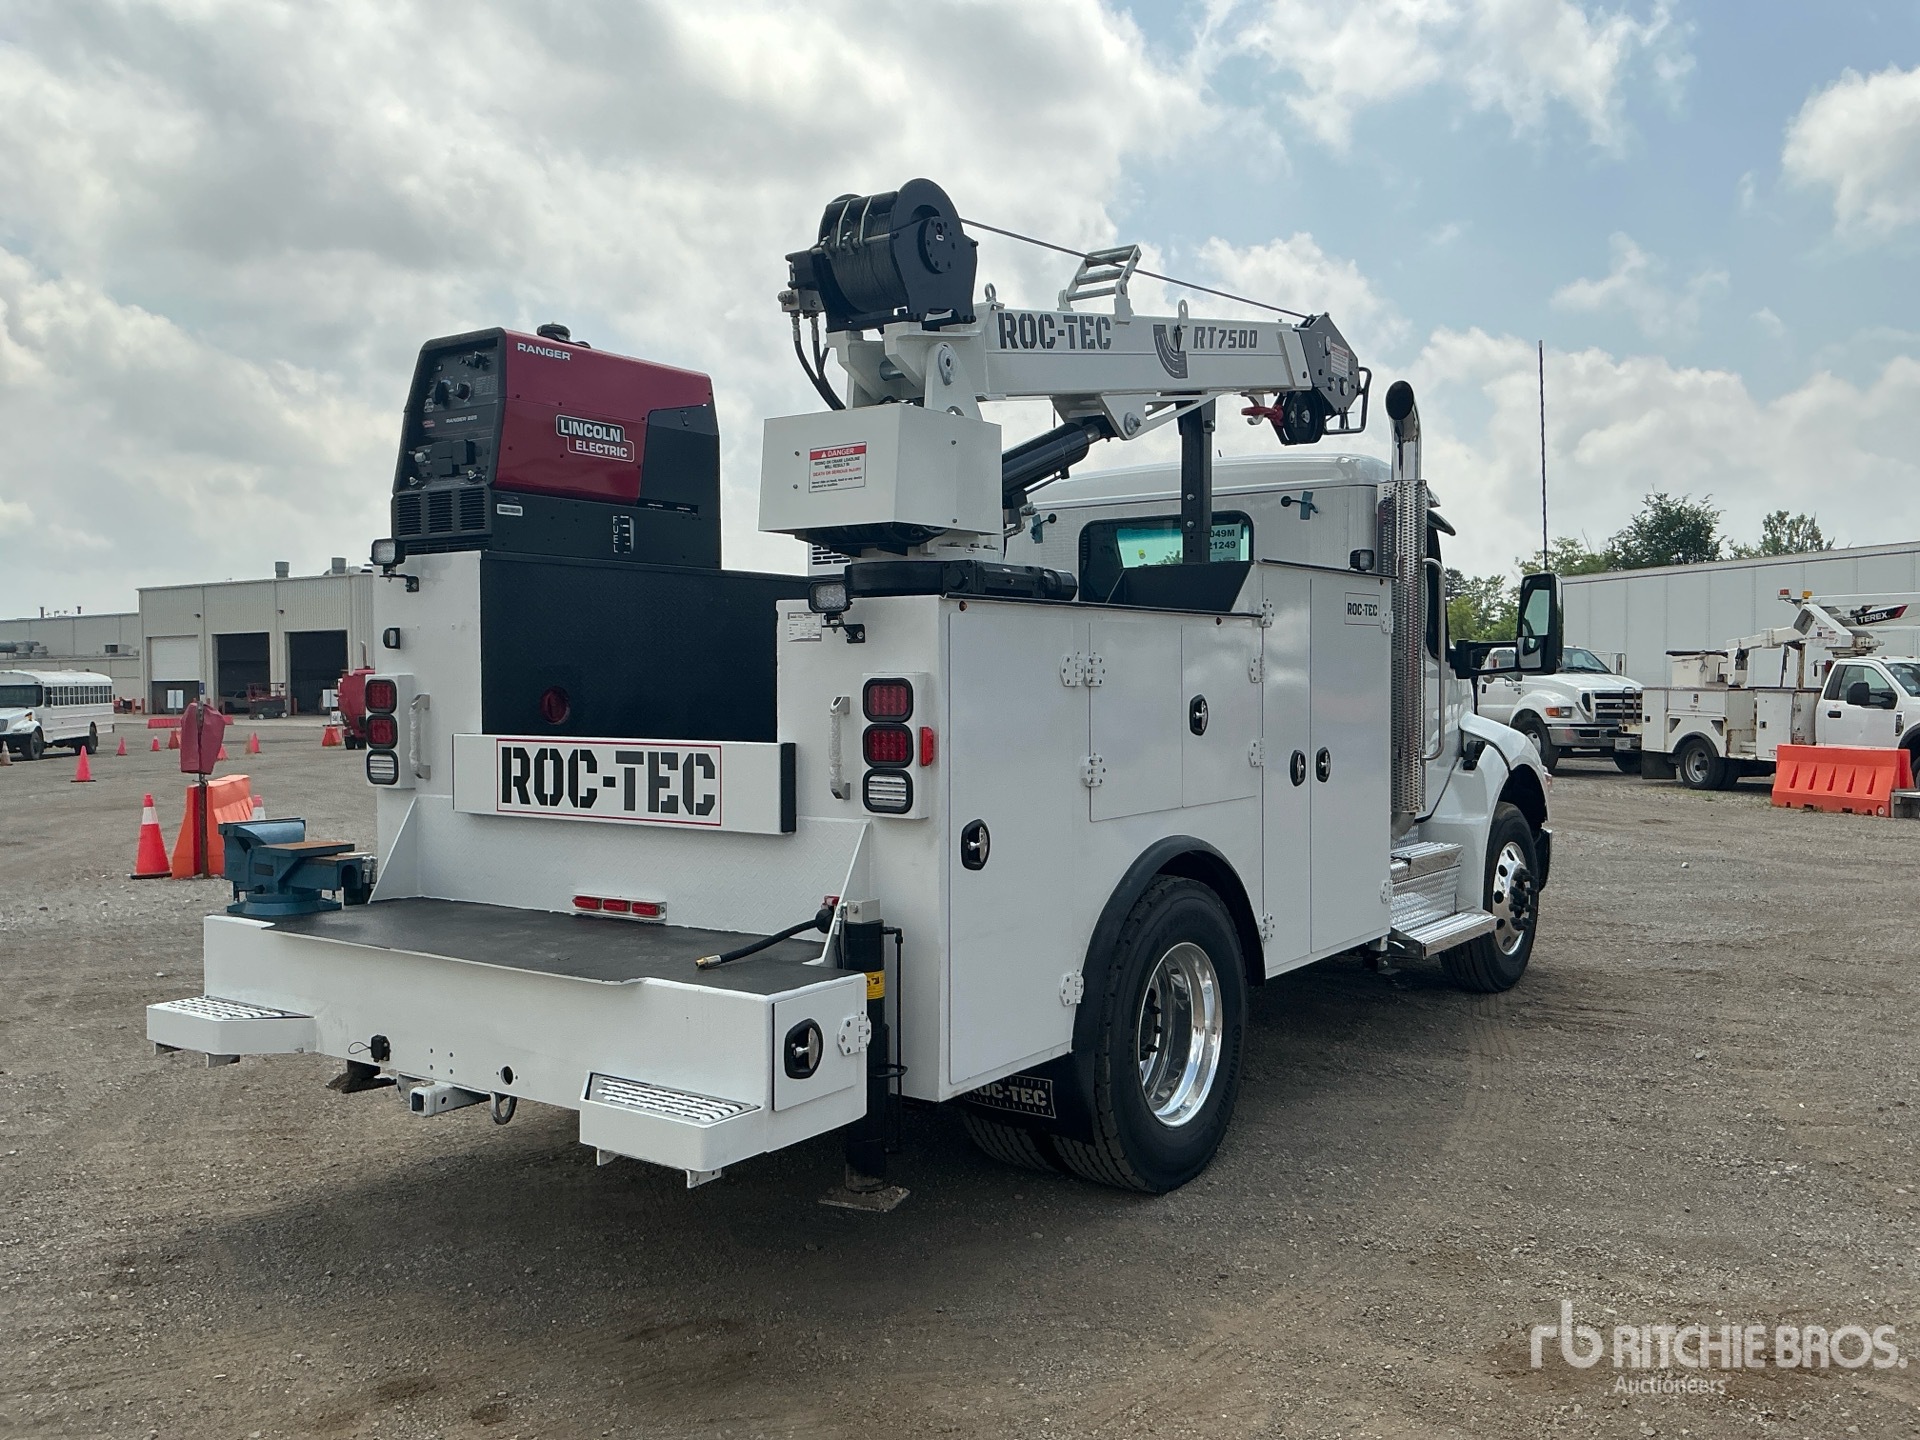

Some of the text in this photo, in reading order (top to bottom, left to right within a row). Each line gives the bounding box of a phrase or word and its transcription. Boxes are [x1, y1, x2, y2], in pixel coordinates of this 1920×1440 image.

[998, 312, 1112, 350] ROC-TEC
[1193, 326, 1258, 349] RT7500
[517, 342, 571, 361] RANGER
[560, 419, 621, 442] LINCOLN
[575, 440, 628, 457] ELECTRIC
[828, 448, 854, 457] DANGER
[1347, 602, 1378, 617] ROC-TEC
[1859, 611, 1888, 624] TEREX
[501, 746, 716, 817] ROC-TEC
[971, 1083, 1048, 1107] OC-TEC
